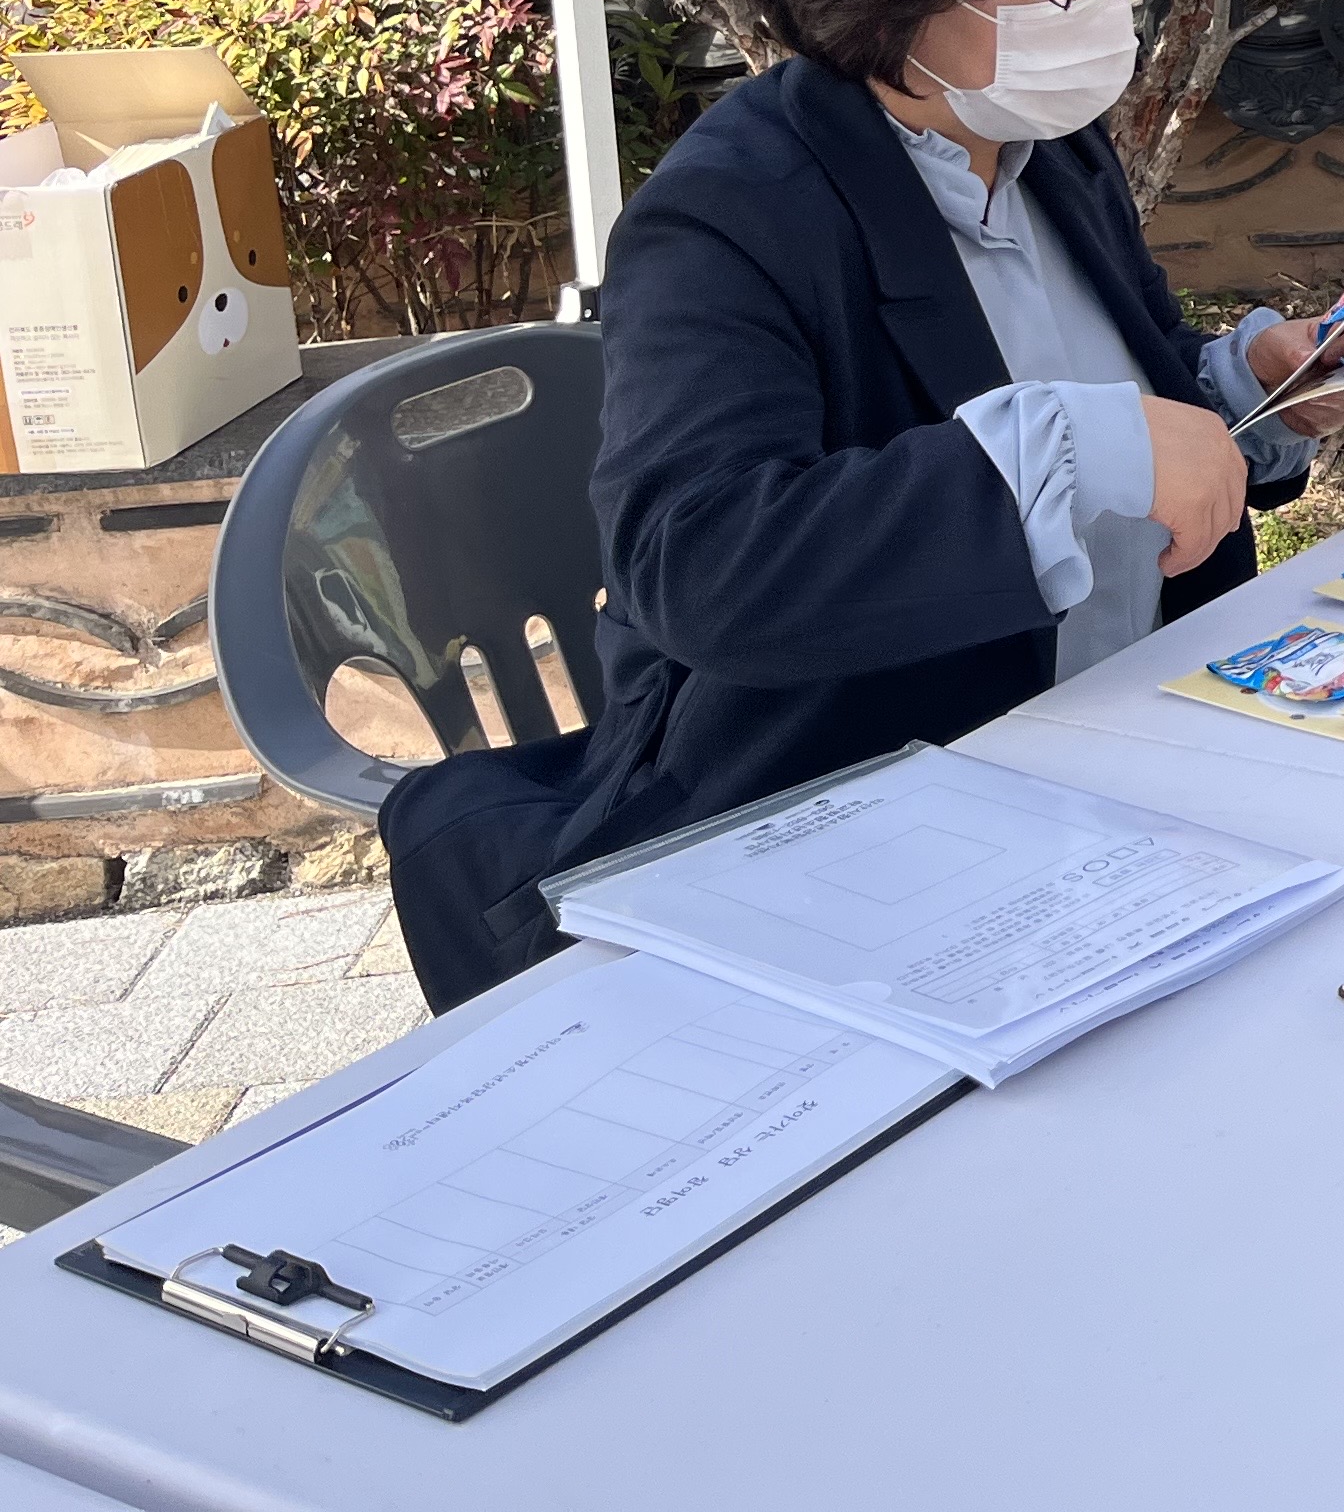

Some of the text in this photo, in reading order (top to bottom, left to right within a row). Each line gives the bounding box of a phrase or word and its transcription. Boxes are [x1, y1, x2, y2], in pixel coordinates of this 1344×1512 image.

[639, 1099, 819, 1218] 찾아가는 상담 참여명단
